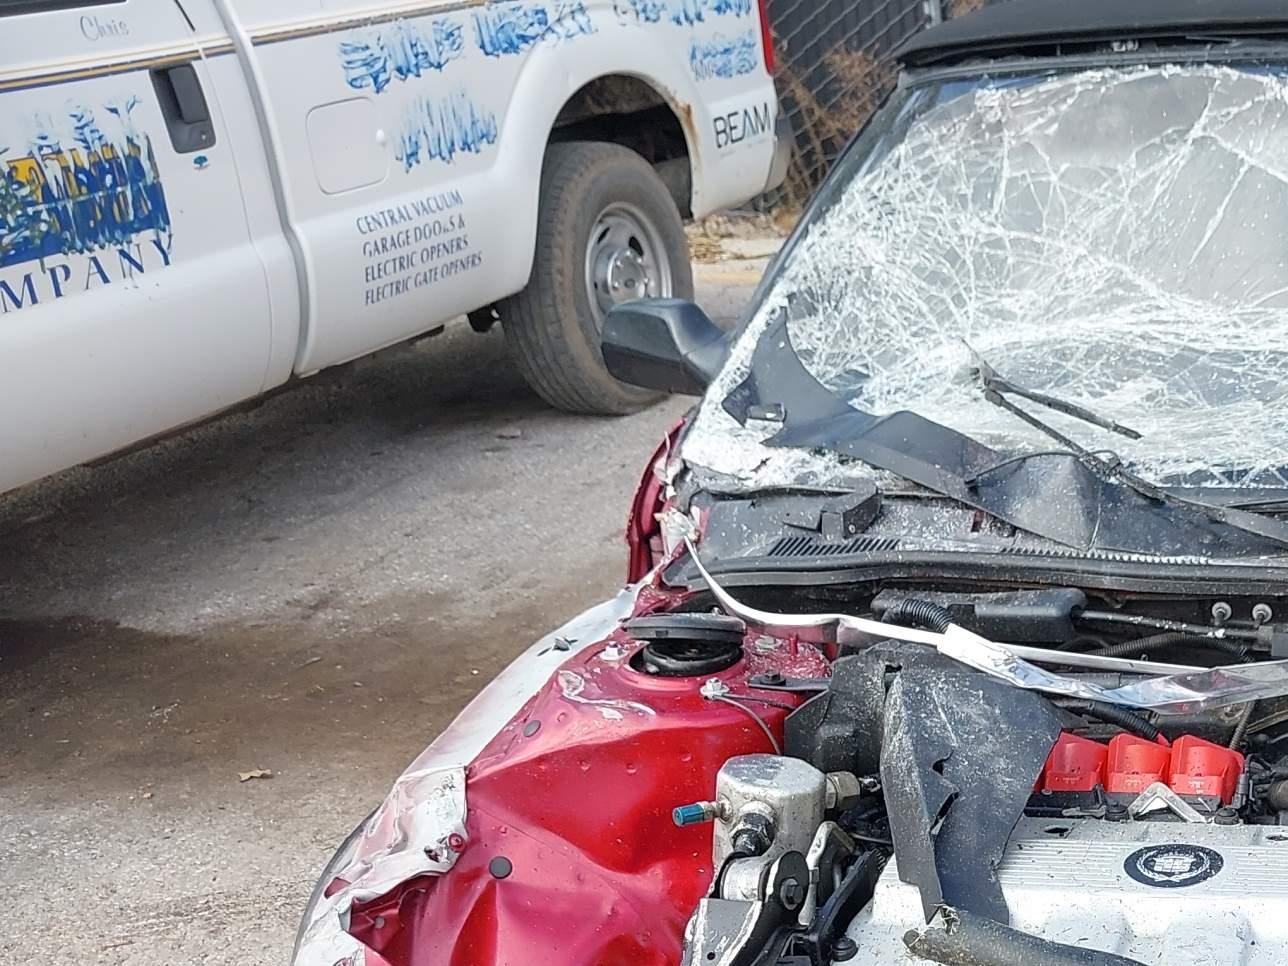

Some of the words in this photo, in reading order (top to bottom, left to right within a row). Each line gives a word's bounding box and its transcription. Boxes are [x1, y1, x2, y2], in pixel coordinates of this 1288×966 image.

[80, 15, 129, 41] Chris
[713, 102, 771, 149] BEAM
[356, 204, 413, 235] CENTRAL
[411, 189, 463, 218] VACUUM
[363, 228, 411, 258] GARAGE
[414, 215, 456, 242] DOOS
[365, 251, 418, 283] ELECTRIC
[420, 233, 469, 264] OPENERS
[414, 266, 439, 289] GATE
[440, 250, 482, 278] OPENERS
